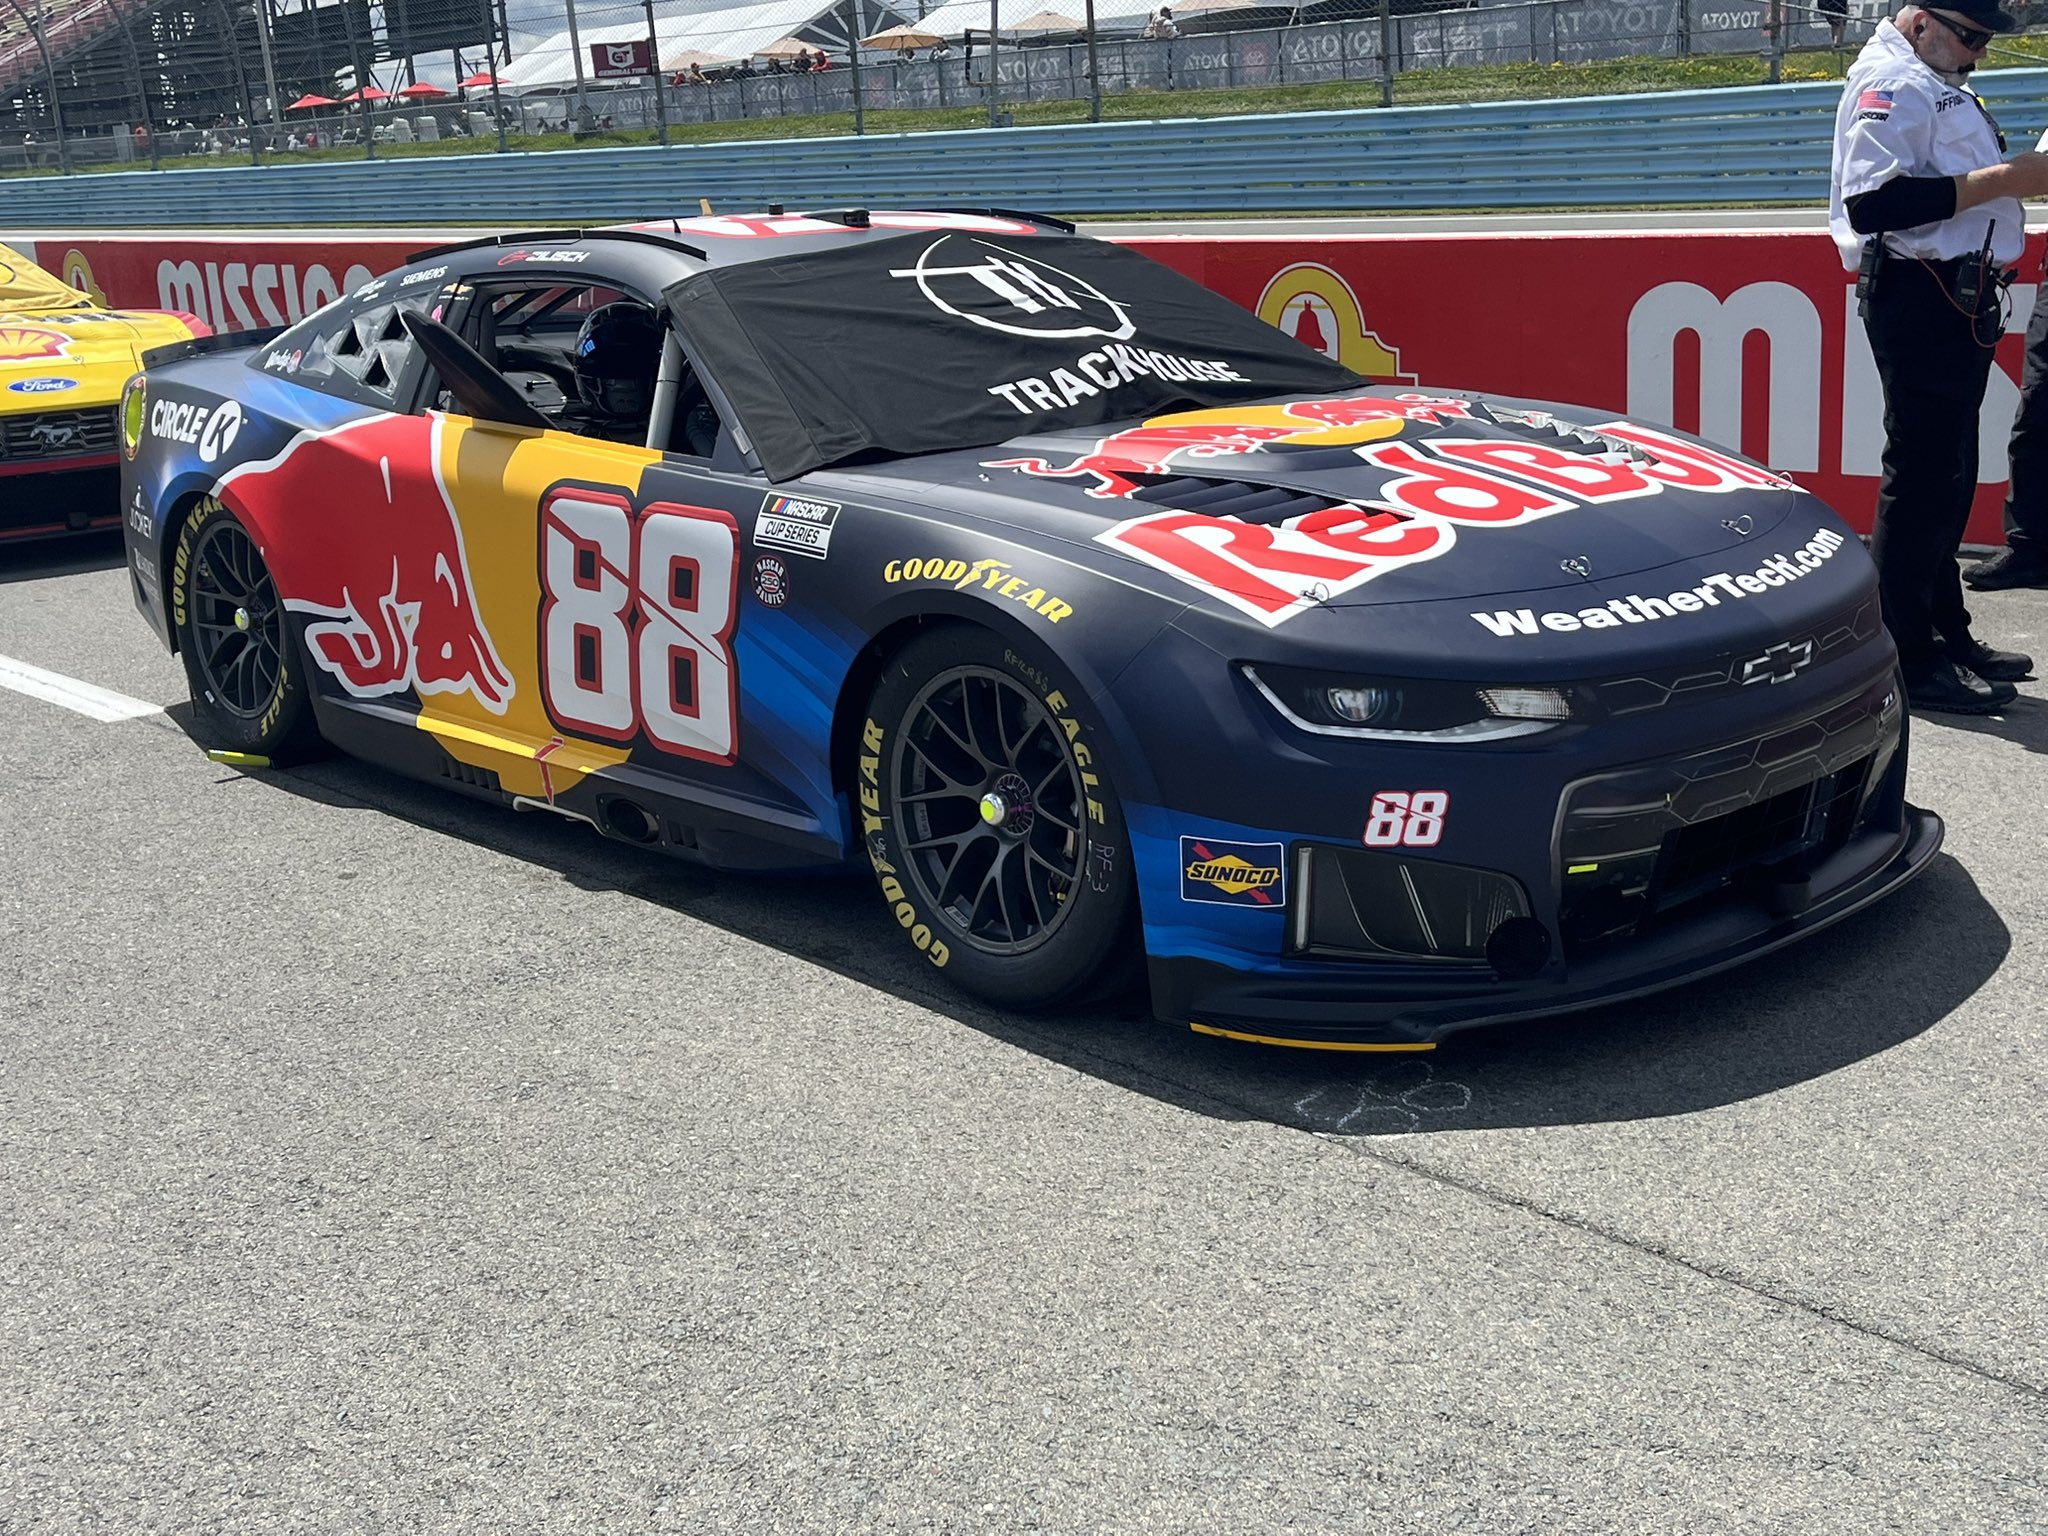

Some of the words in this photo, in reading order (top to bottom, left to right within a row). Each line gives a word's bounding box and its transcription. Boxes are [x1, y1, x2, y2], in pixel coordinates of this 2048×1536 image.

[400, 266, 448, 287] SIEMENS
[157, 259, 376, 334] MISSIO
[22, 379, 66, 392] Ford
[151, 399, 209, 444] CIRCLE
[202, 405, 240, 461] K
[784, 500, 828, 521] NASCAR
[765, 521, 786, 536] CUP
[784, 524, 820, 544] SERIES
[756, 559, 785, 577] NASCAR
[761, 576, 780, 587] 250
[755, 586, 785, 605] SALUTES
[543, 490, 737, 763] 88
[1046, 690, 1104, 825] EAGLE
[1363, 791, 1449, 847] 88
[1190, 863, 1277, 886] SUNOCO
